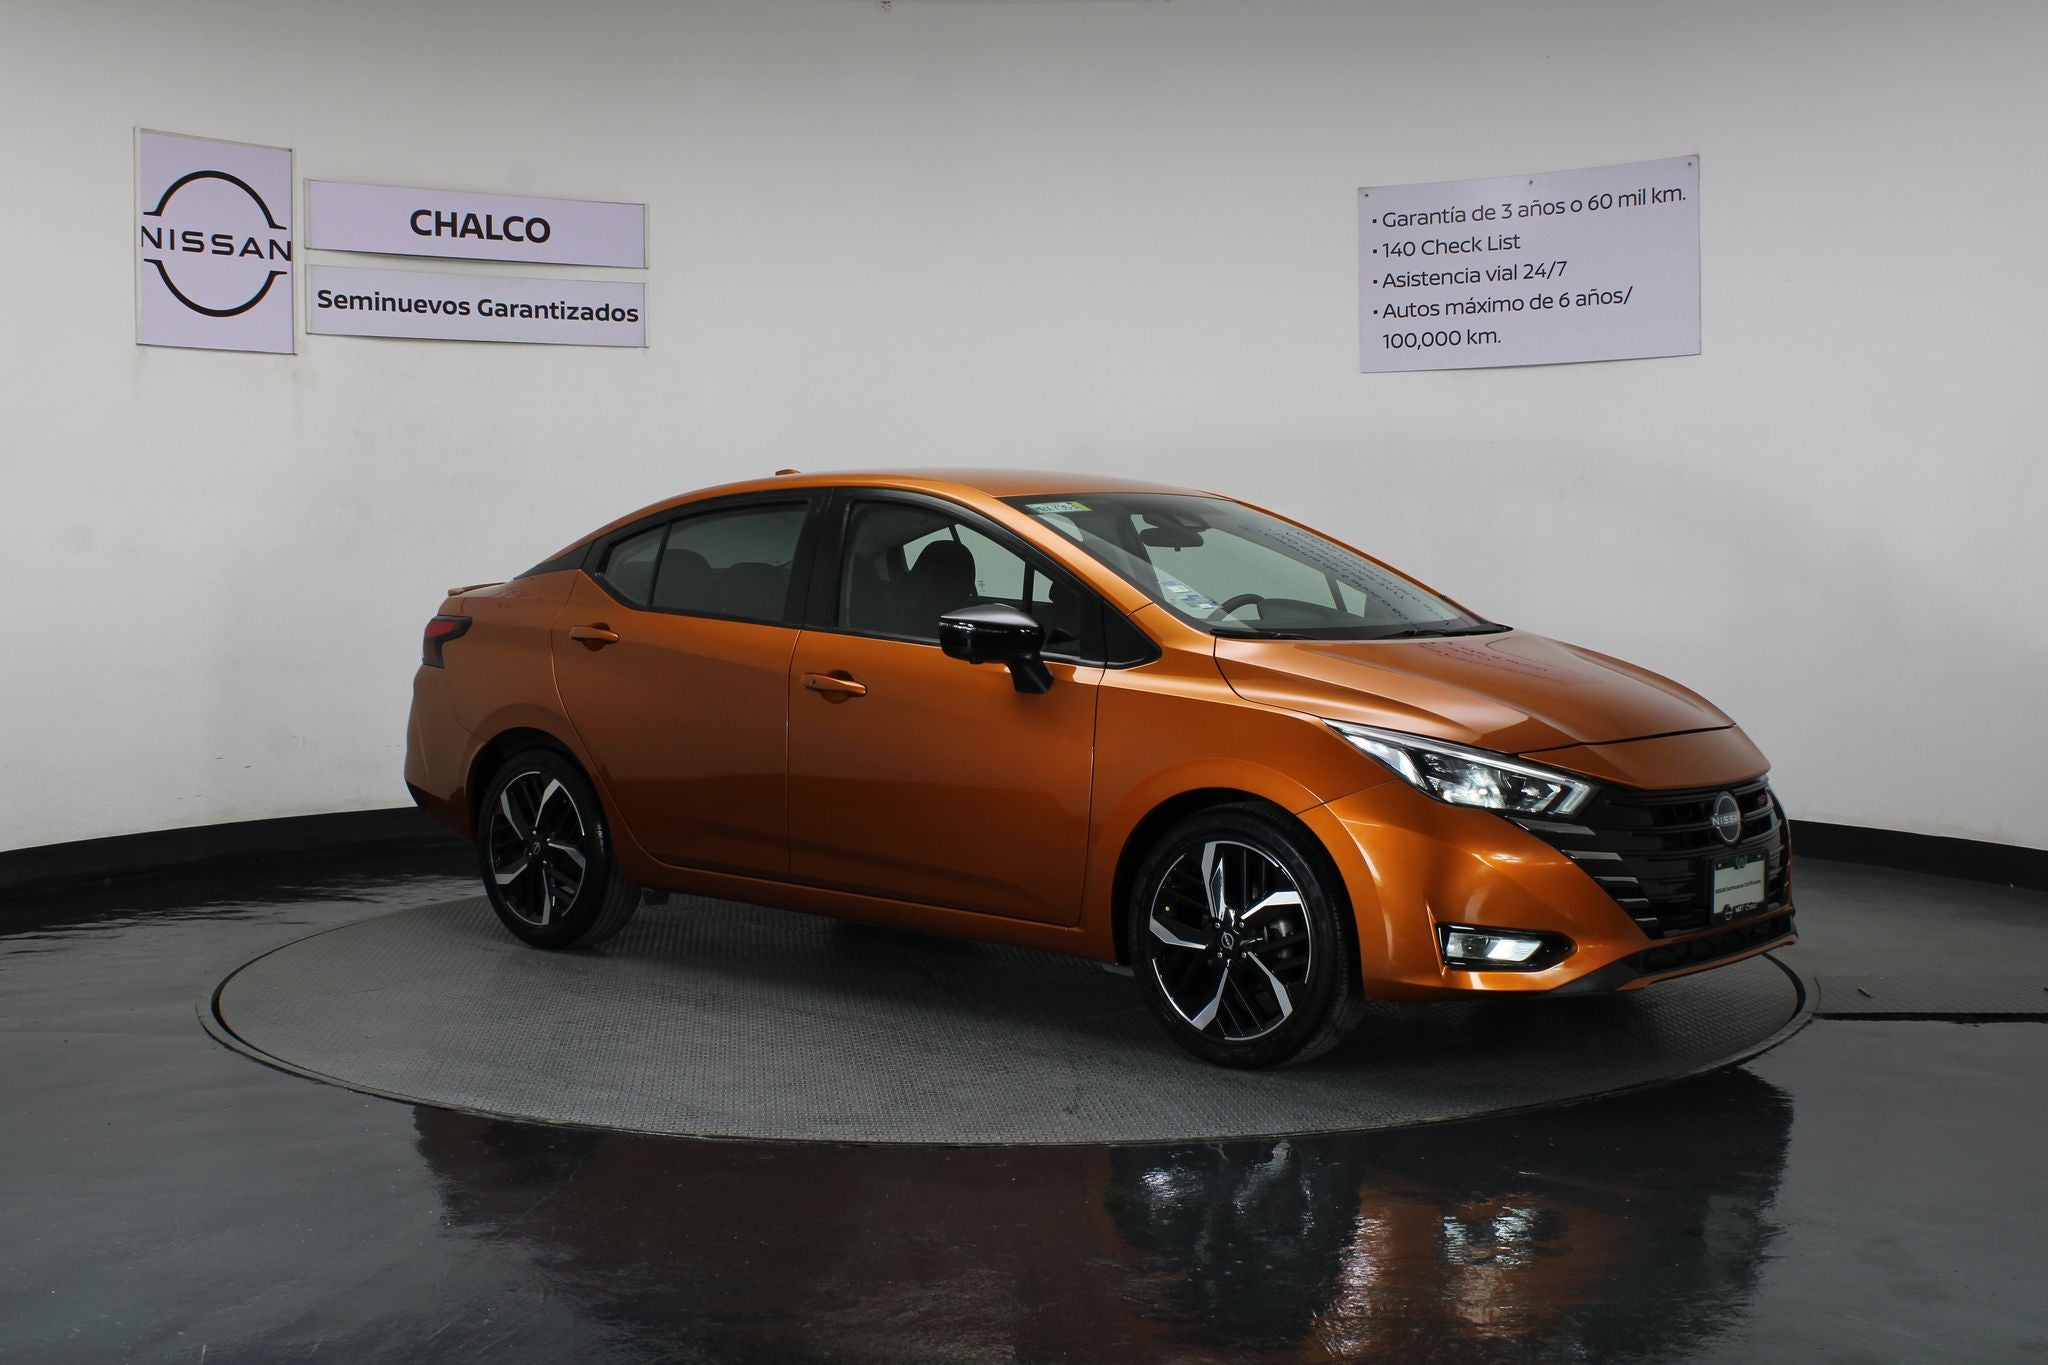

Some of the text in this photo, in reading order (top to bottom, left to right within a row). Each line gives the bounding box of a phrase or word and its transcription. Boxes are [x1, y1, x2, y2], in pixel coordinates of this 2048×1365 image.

[1382, 186, 1687, 228] Garantía de 3 años o 60 mil km.
[410, 208, 551, 244] CHALCO
[141, 225, 292, 262] NISSAN
[1381, 233, 1522, 259] 140 Check List
[1381, 260, 1568, 289] Asistencia vial 24/7
[317, 289, 639, 323] Seminuevos Garantizados
[1382, 286, 1634, 320] Autos máximo de 6 años/
[1382, 328, 1502, 351] 100,000 km.
[1711, 814, 1740, 826] NISS
